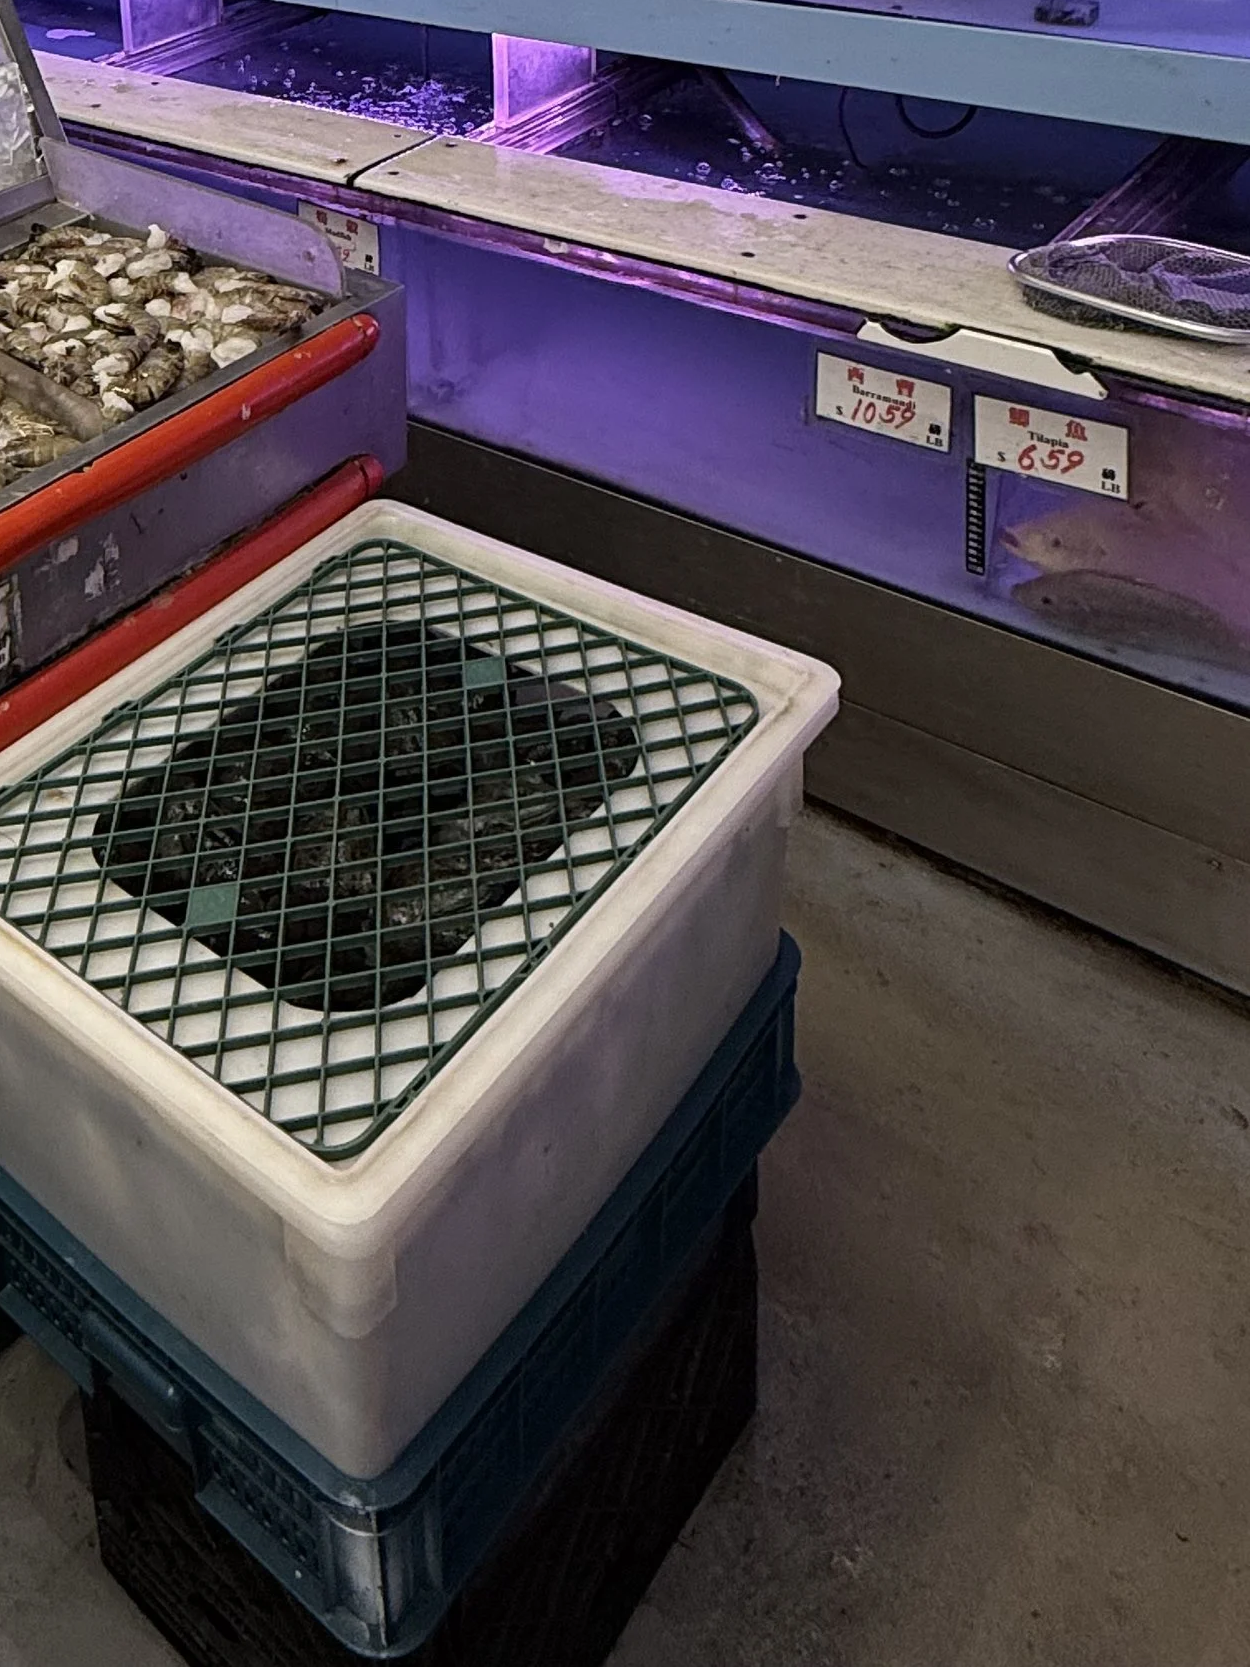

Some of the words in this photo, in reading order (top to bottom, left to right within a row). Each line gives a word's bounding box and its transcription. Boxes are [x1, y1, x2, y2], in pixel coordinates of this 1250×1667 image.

[926, 435, 944, 447] LB
[1027, 430, 1070, 449] Tilapia
[1101, 481, 1121, 495] LB
